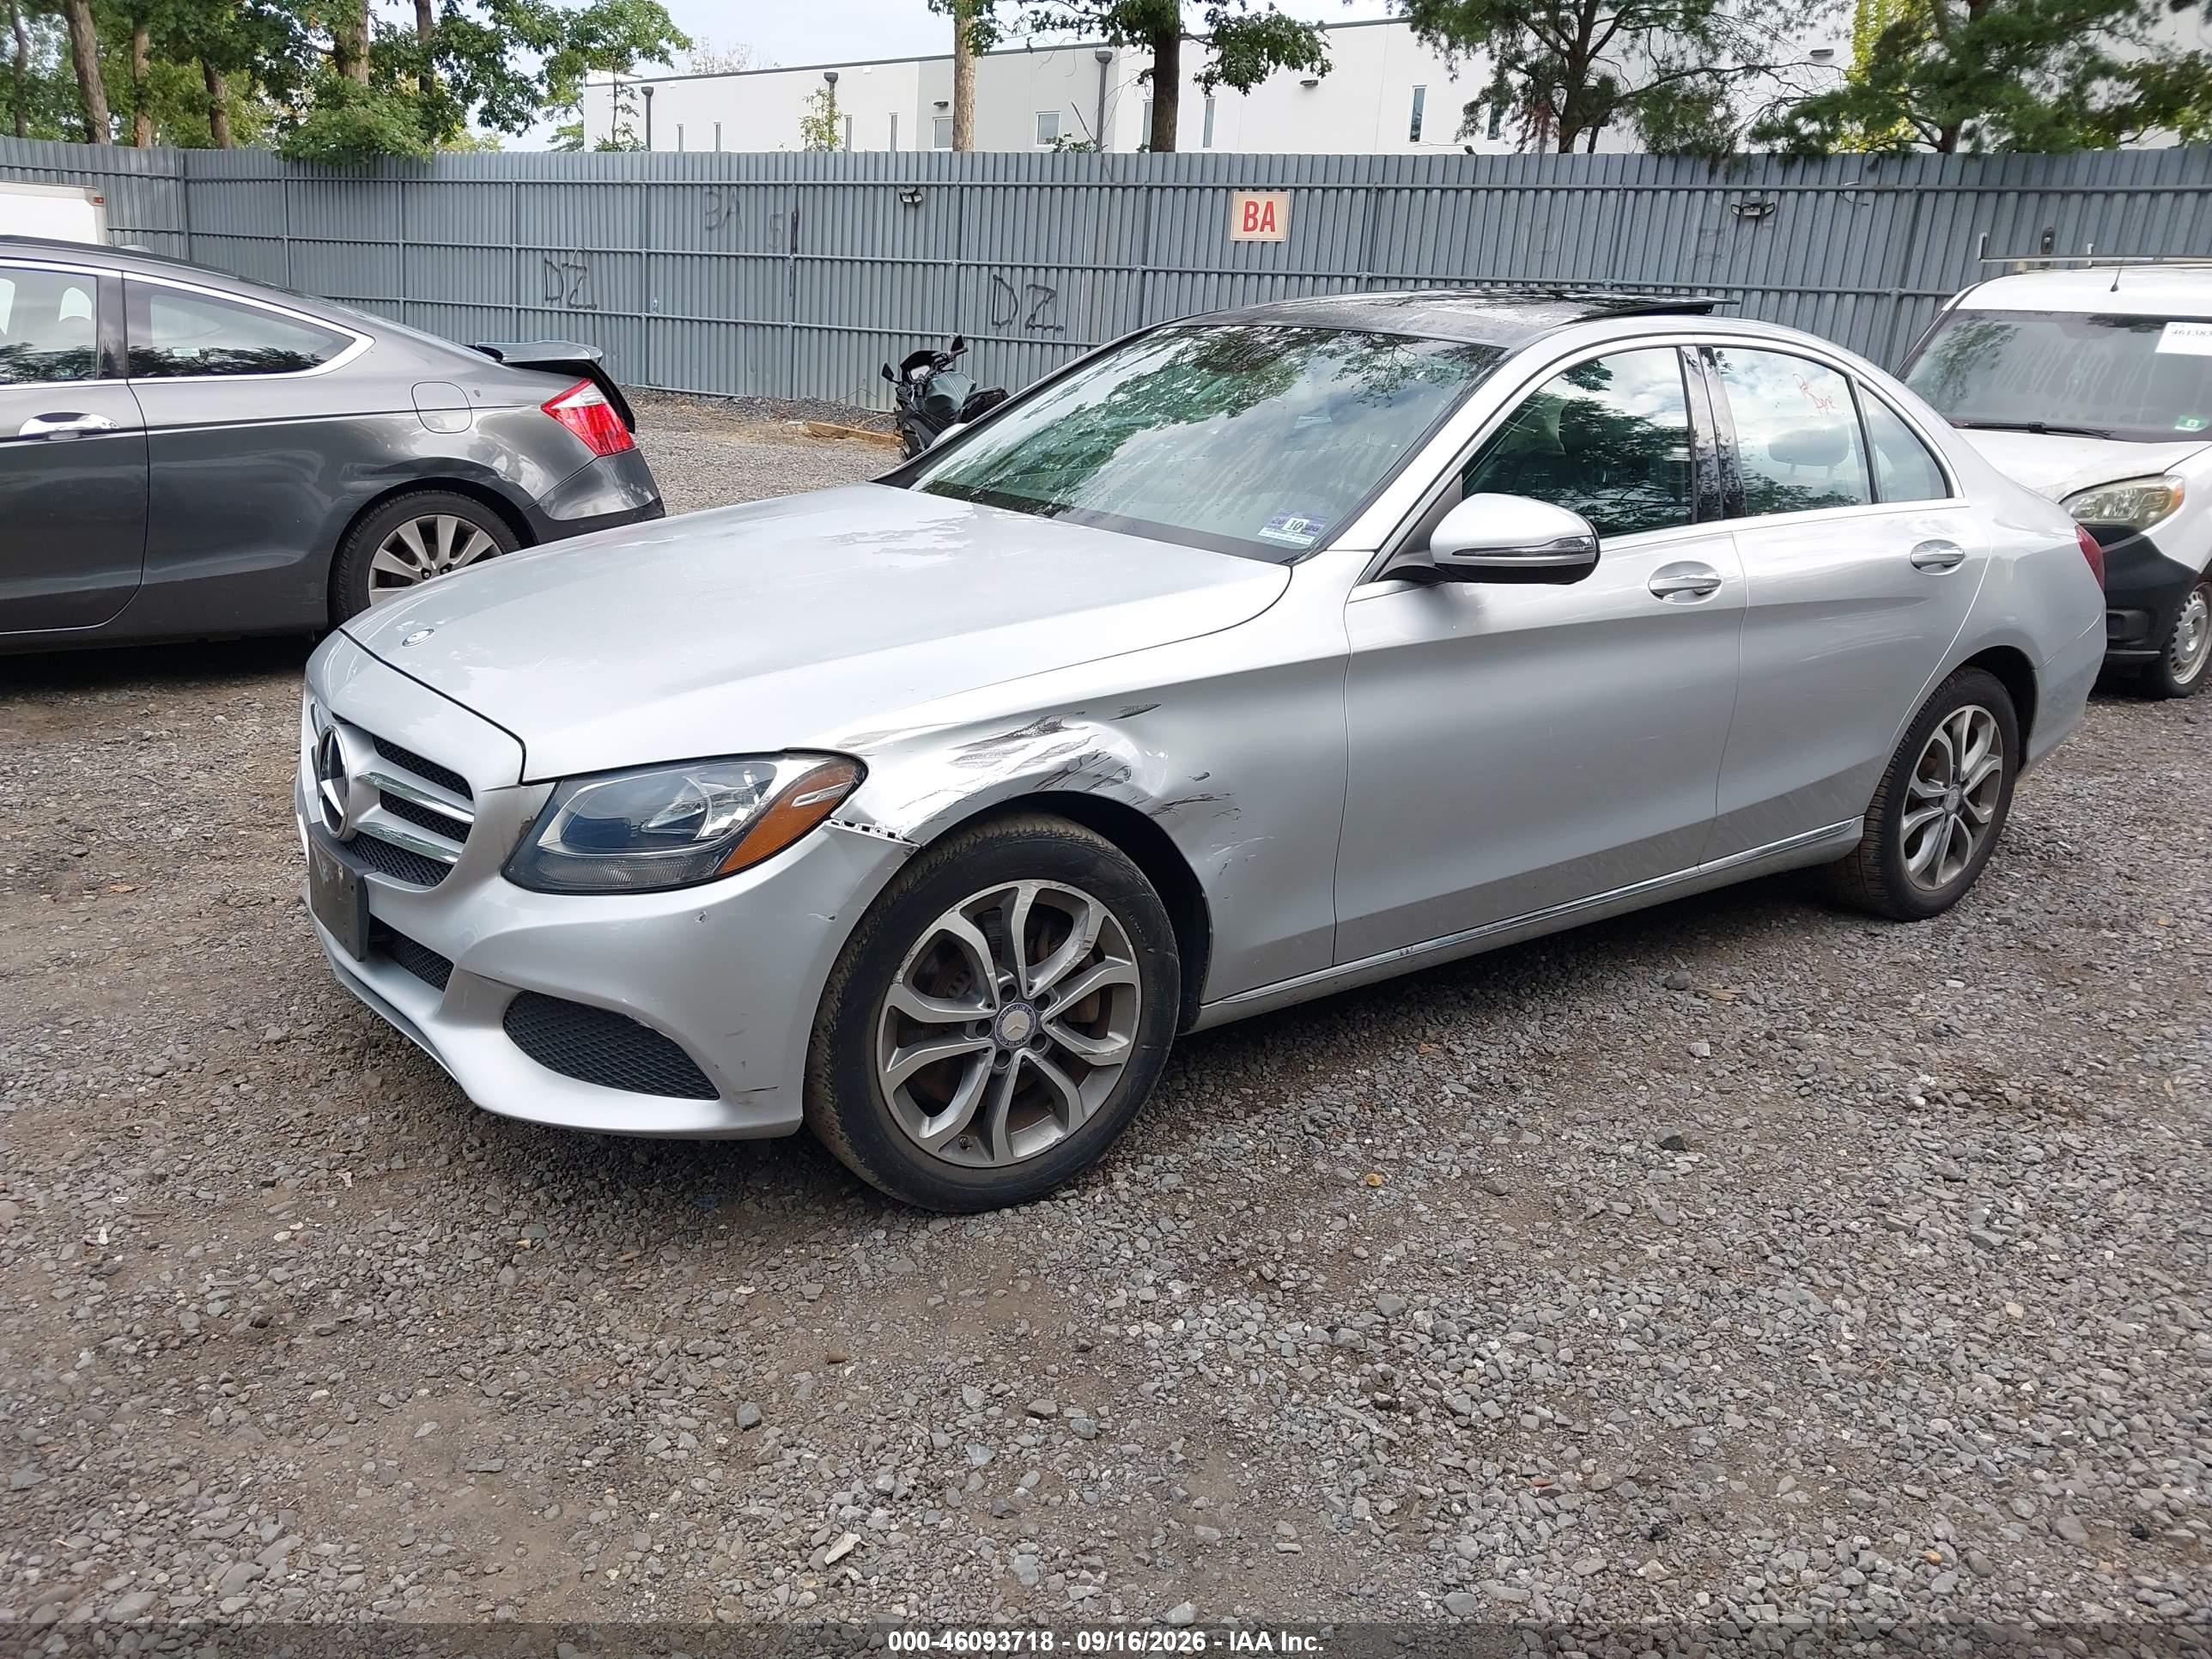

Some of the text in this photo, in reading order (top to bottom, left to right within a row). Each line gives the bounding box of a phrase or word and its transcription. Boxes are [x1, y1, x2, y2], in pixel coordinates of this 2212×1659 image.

[1243, 201, 1276, 233] BA
[544, 258, 598, 310] DZ
[991, 274, 1065, 331] DZ
[1287, 520, 1305, 531] 10
